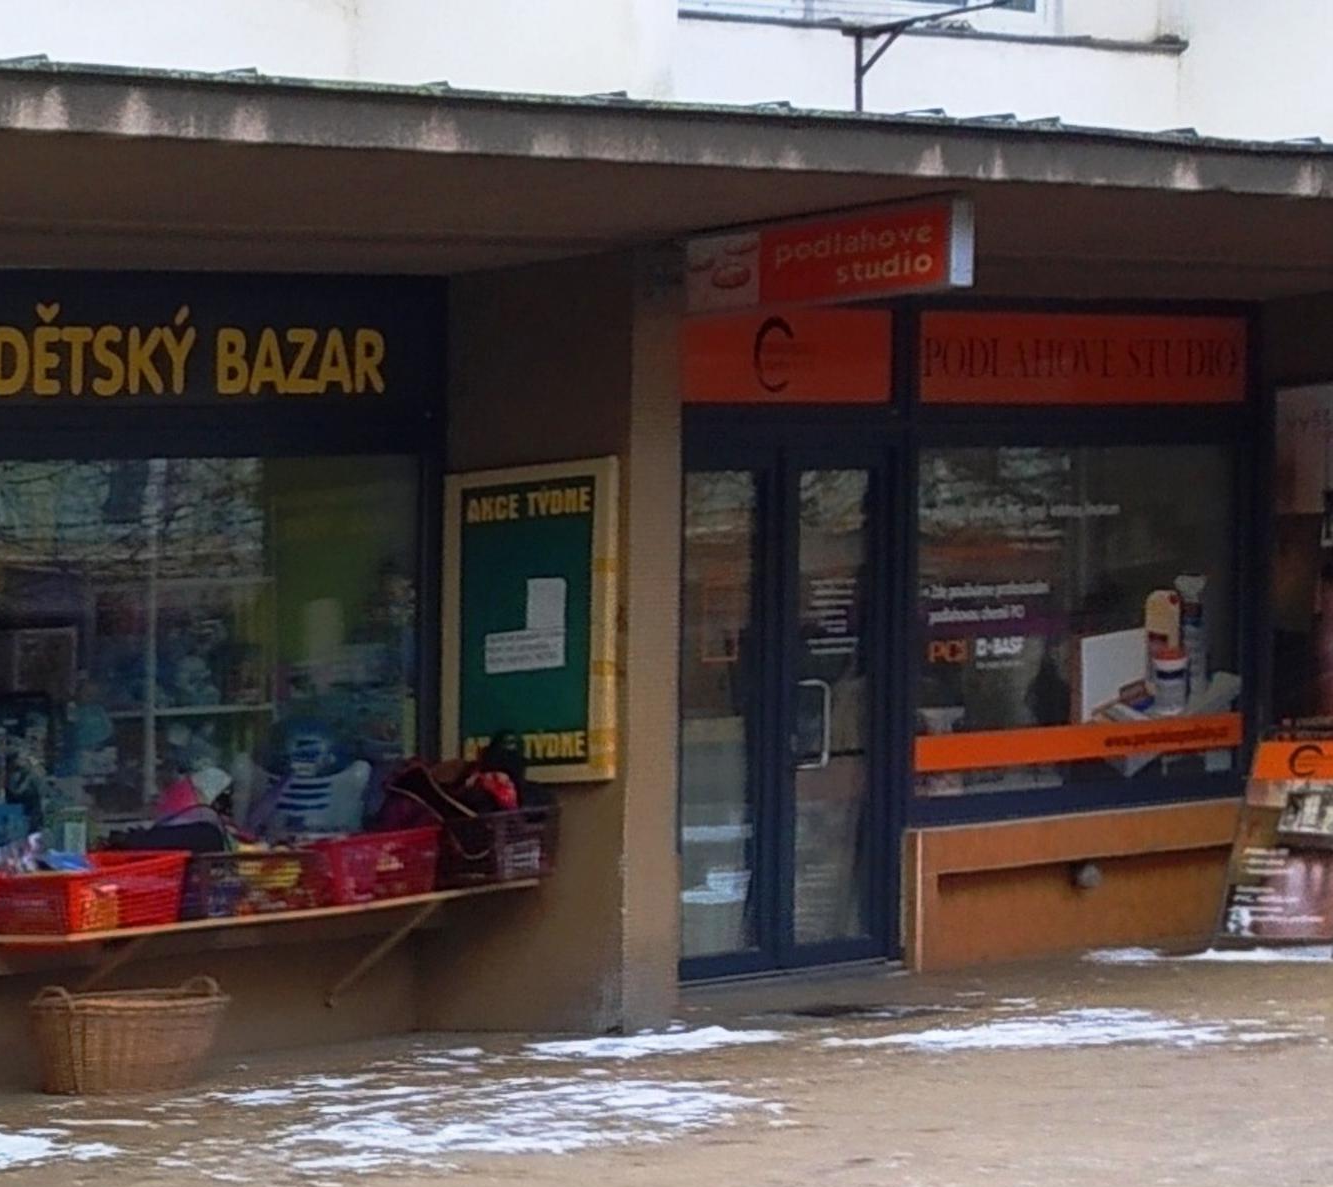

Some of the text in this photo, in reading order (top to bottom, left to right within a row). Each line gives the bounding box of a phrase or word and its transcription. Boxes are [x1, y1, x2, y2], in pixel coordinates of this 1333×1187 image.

[836, 249, 934, 284] studio
[216, 326, 384, 395] BAZAR
[1124, 335, 1239, 377] STUDIO
[466, 485, 592, 525] AKCE TÝDNE
[523, 728, 587, 760] TÝDNE
